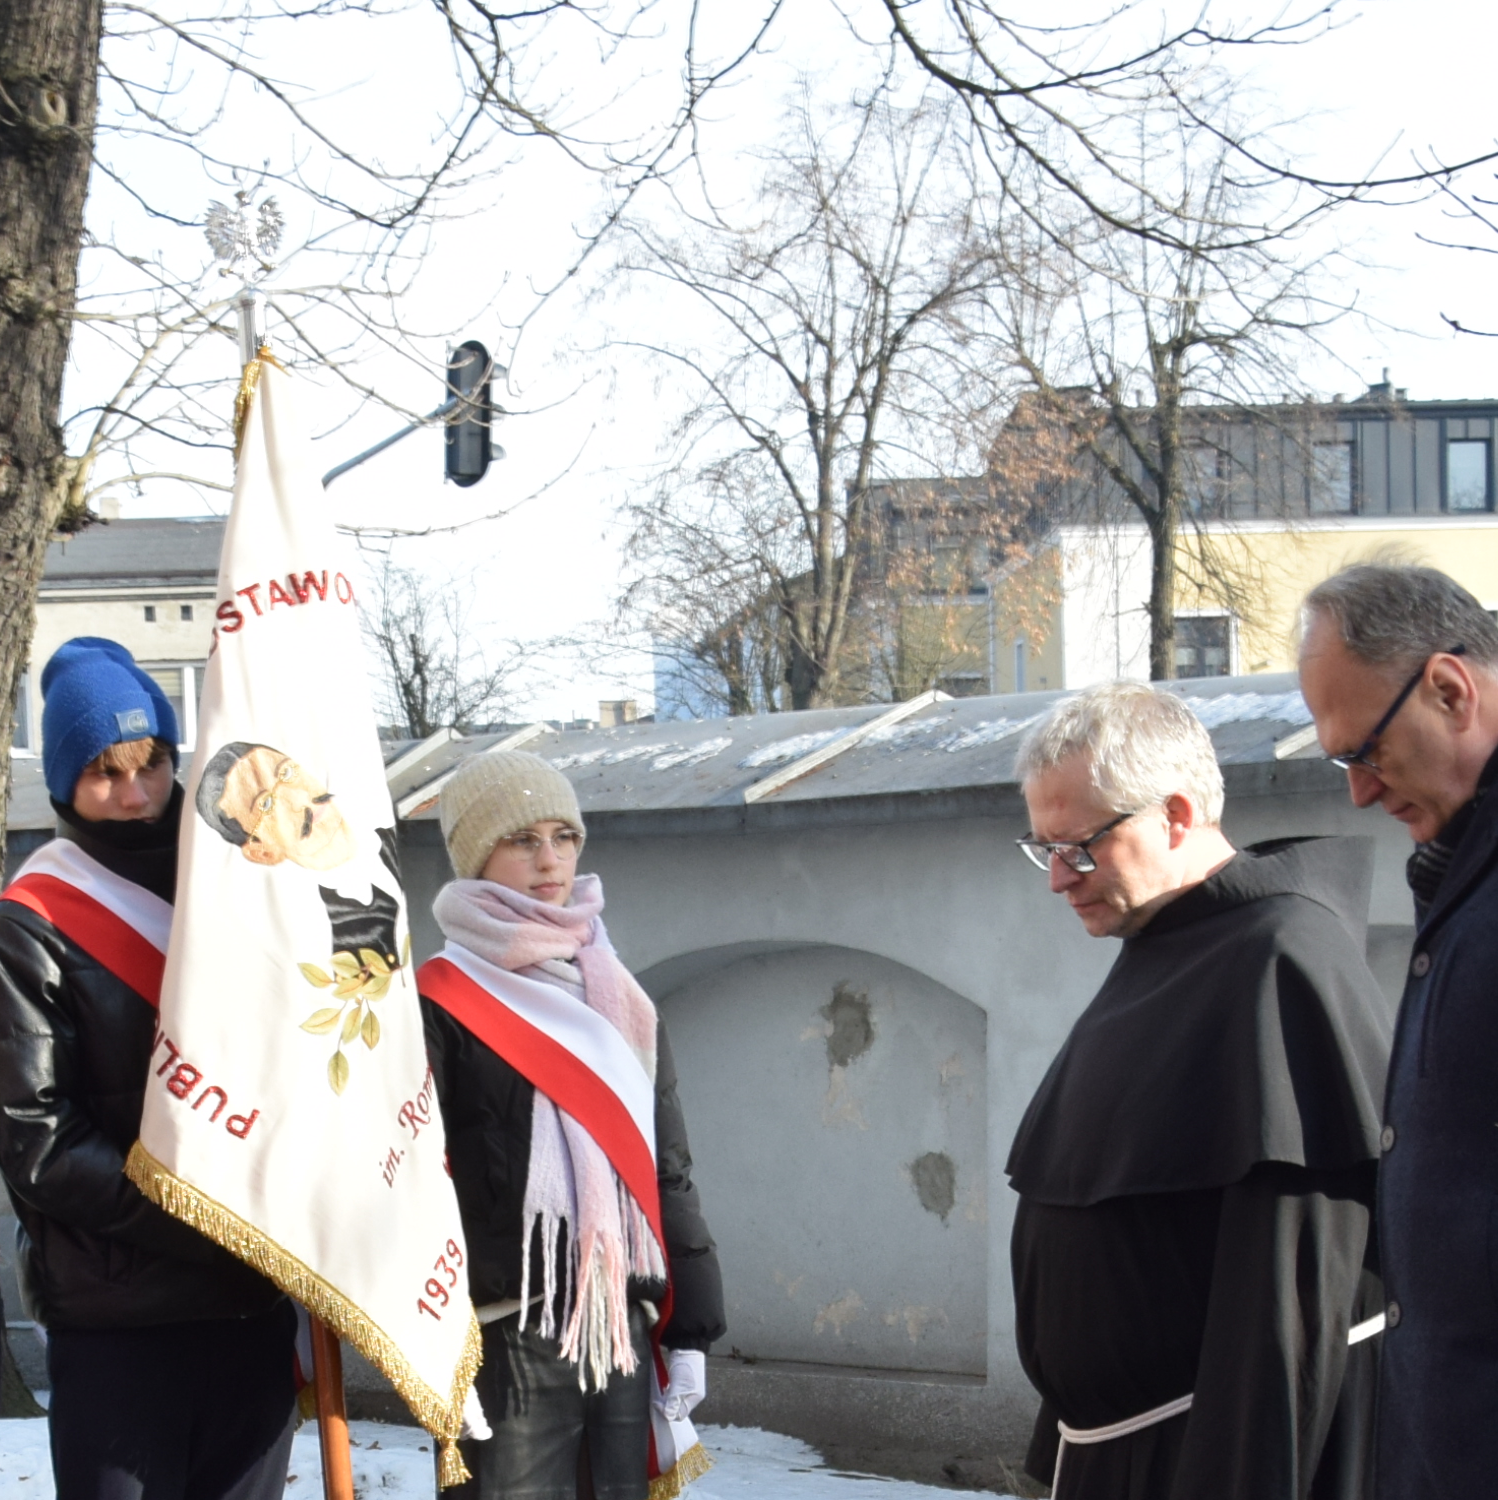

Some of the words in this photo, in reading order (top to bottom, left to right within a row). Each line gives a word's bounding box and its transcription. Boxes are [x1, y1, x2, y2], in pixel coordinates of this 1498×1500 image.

[208, 569, 358, 658] STAWO
[151, 1012, 260, 1140] PUBLI
[379, 1147, 405, 1189] im.
[397, 1061, 433, 1140] Rom
[416, 1238, 463, 1321] 1939
